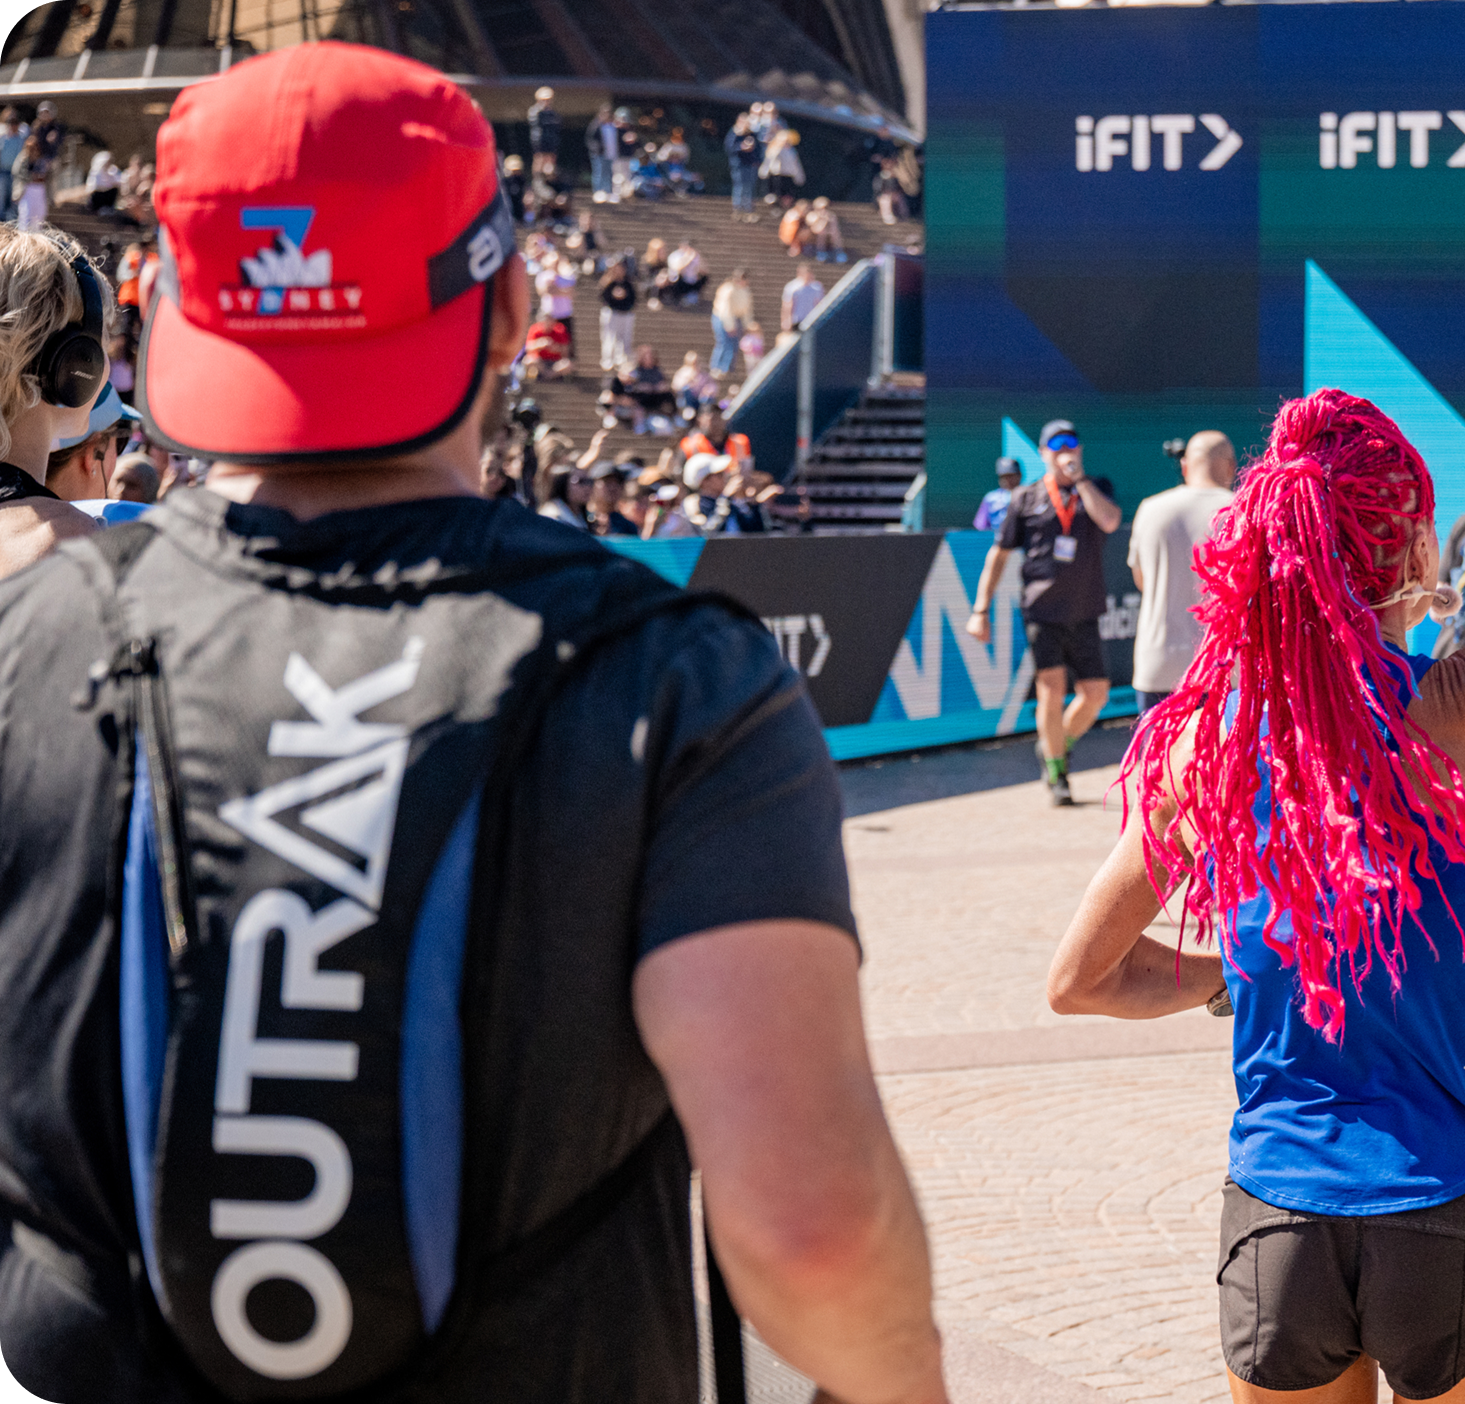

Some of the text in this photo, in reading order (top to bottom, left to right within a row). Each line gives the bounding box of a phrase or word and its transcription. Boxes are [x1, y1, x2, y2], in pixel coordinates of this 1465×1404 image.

[1075, 114, 1196, 172] iFIT
[1319, 110, 1443, 169] iFIT
[210, 634, 426, 1381] OUTRAK
